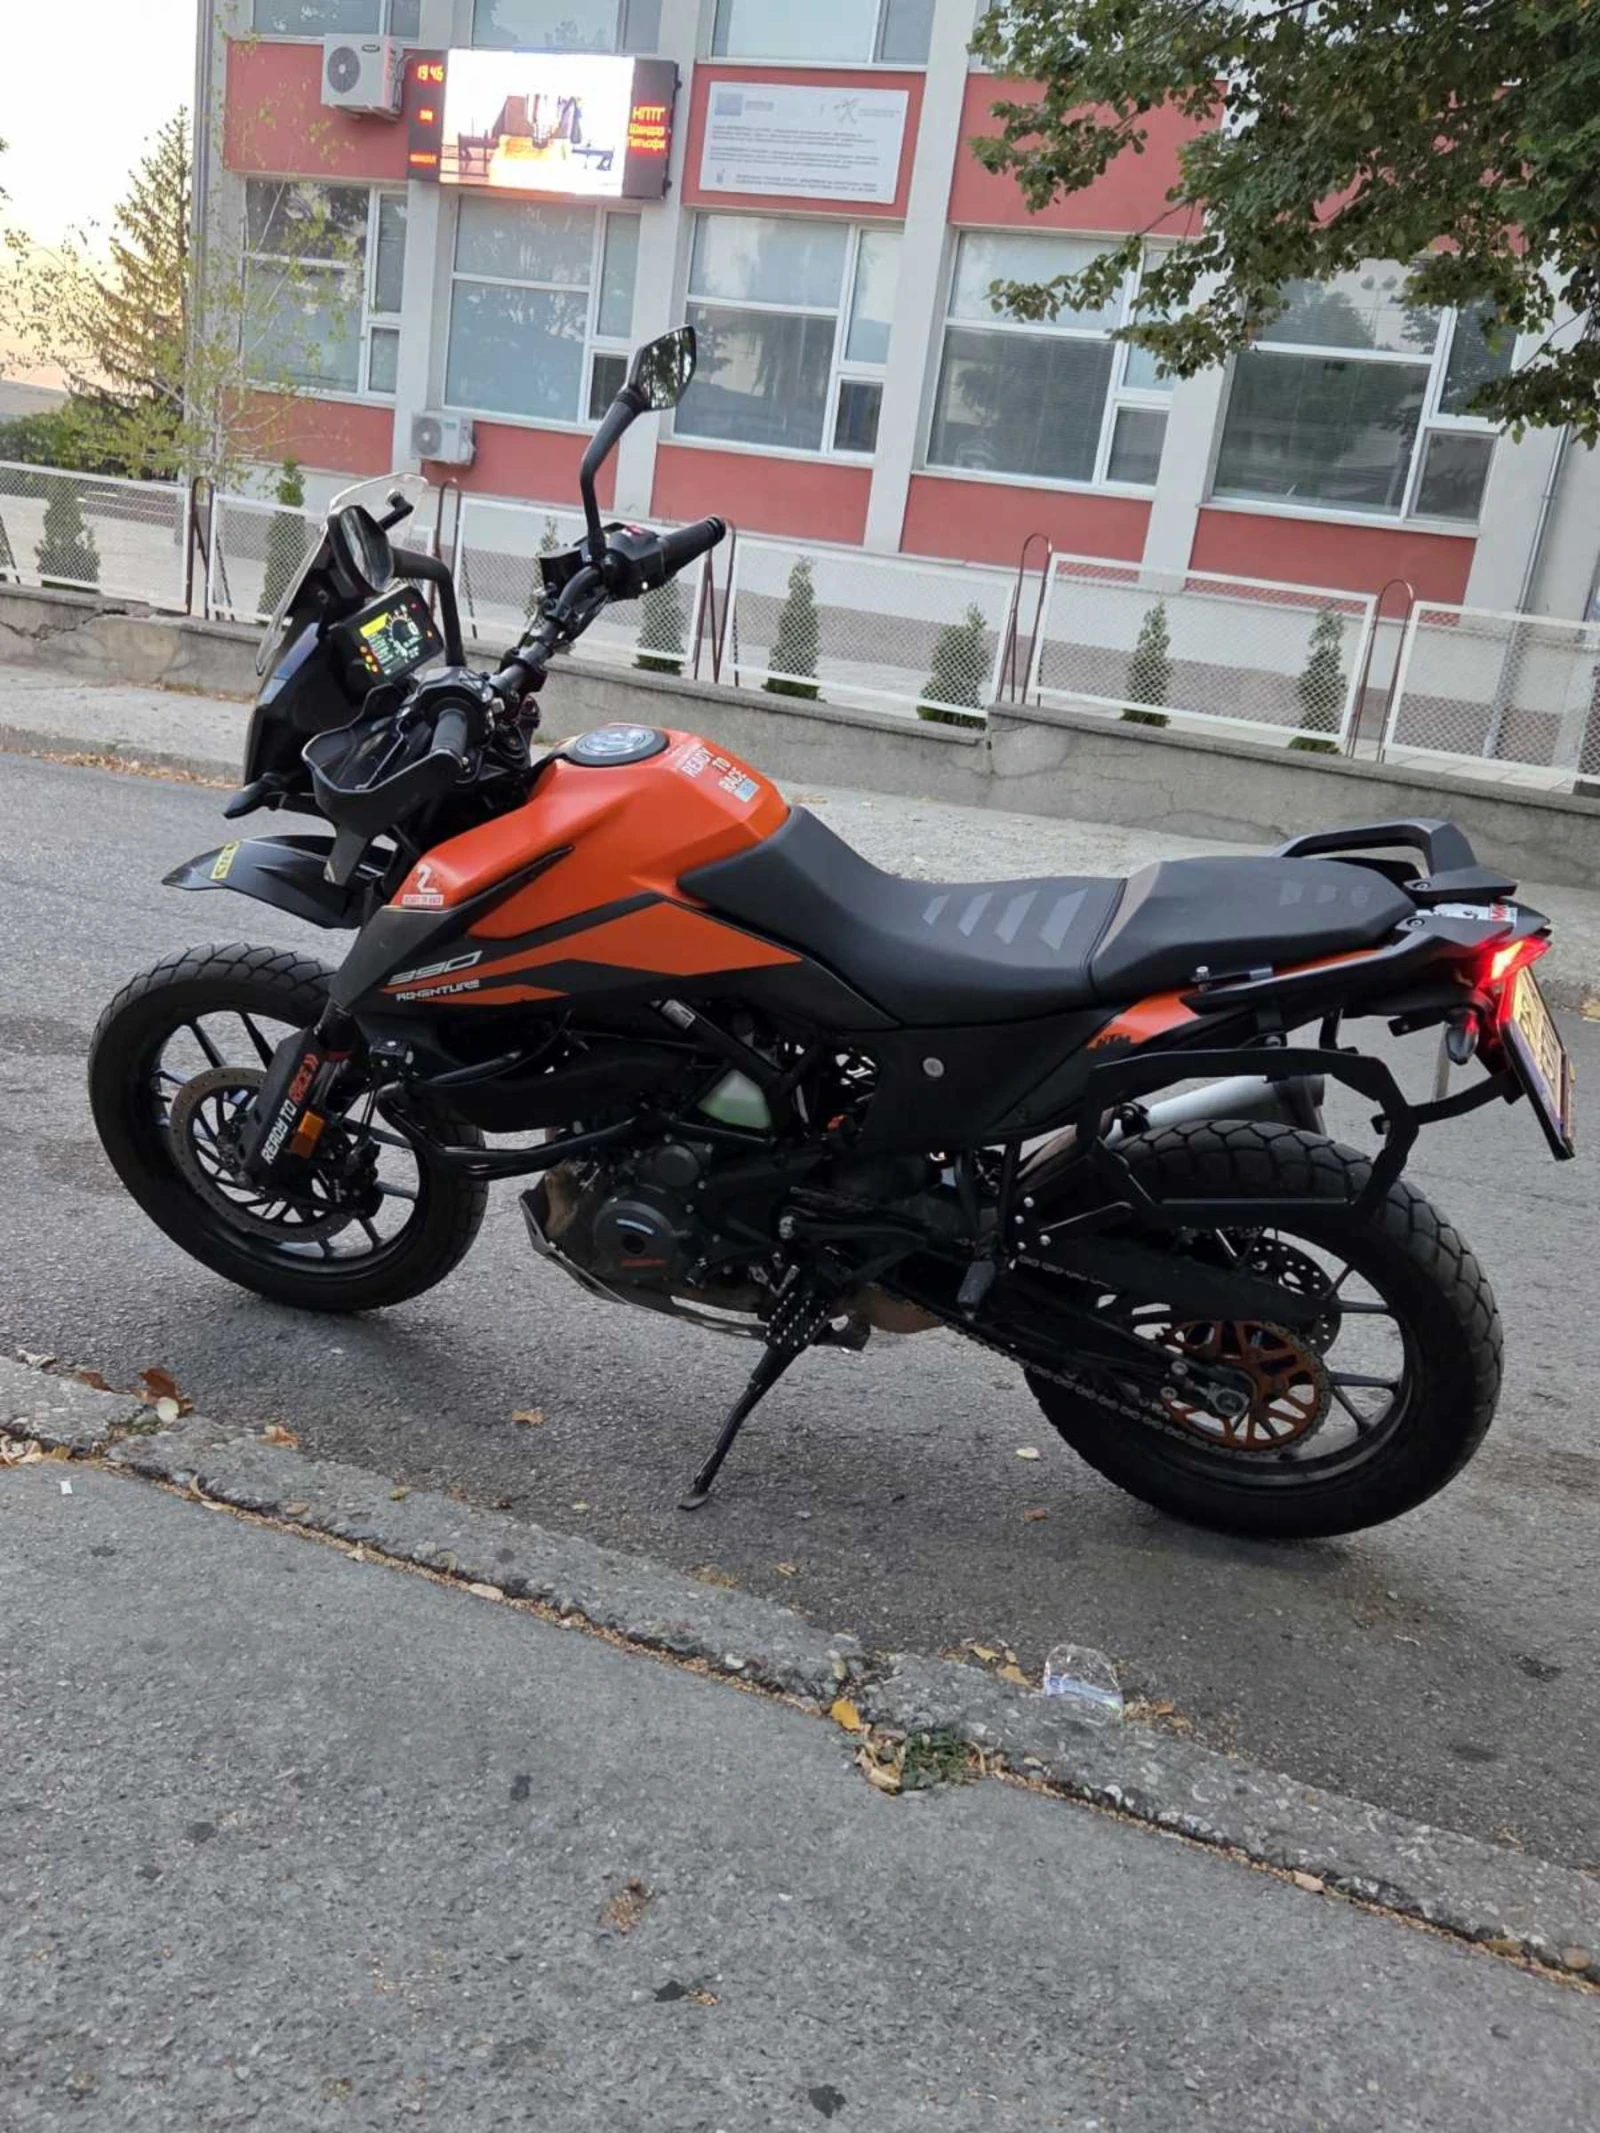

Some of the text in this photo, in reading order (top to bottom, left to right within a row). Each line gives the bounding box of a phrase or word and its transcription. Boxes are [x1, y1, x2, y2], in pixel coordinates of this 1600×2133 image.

[681, 746, 714, 778] READY
[712, 757, 731, 773] TO
[261, 1116, 289, 1165] READY
[280, 1098, 298, 1122] TO
